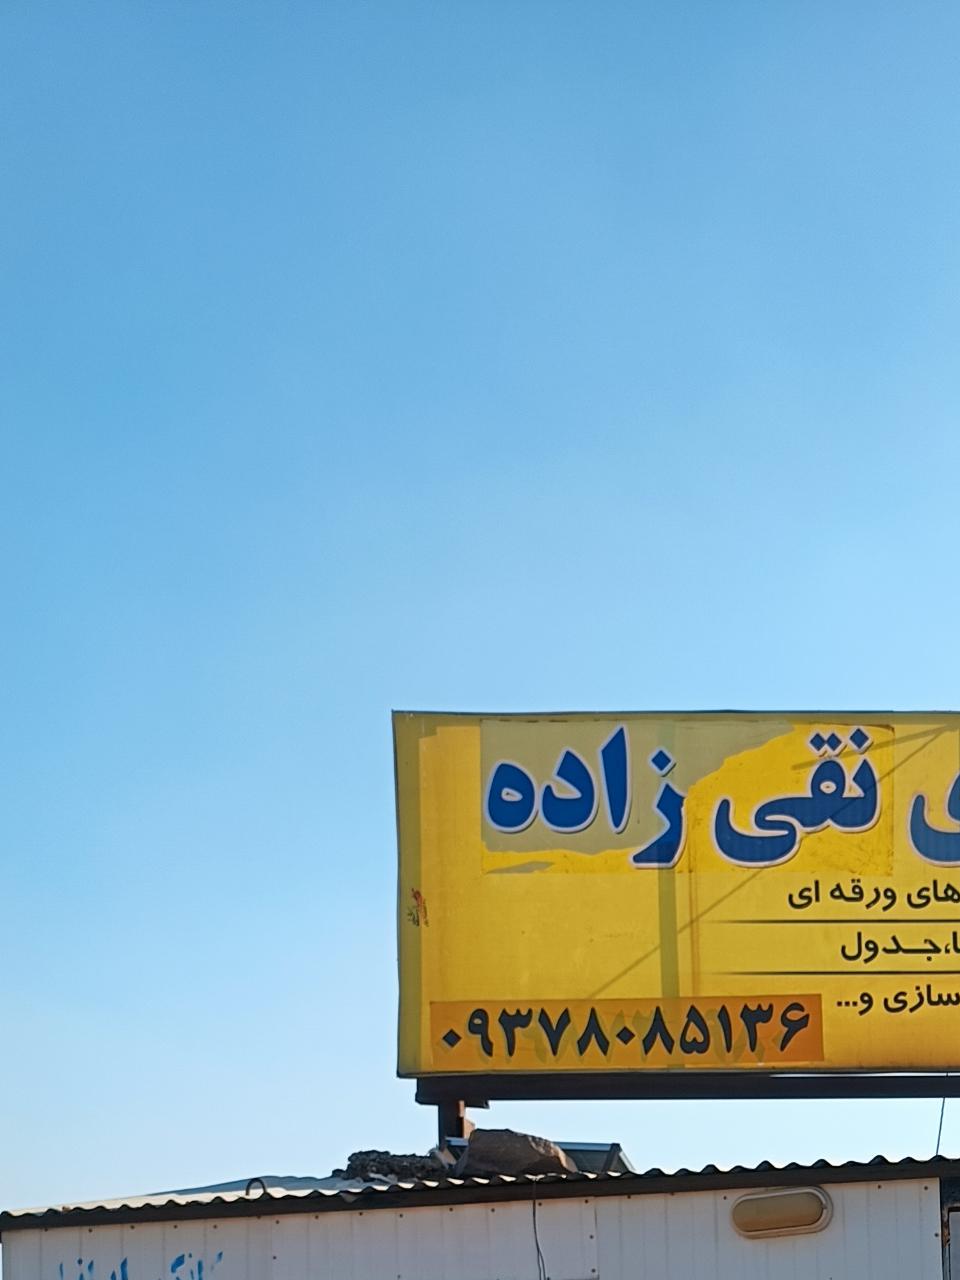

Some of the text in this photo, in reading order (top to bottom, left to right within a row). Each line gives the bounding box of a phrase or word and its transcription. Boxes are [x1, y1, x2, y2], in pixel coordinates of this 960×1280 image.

[484, 725, 687, 868] زاده
[712, 726, 881, 866] نقی
[787, 879, 821, 909] ای
[829, 881, 898, 911] ورقه
[442, 1002, 810, 1058] ۰۹۳۷۸۰۸۵۱۳۶
